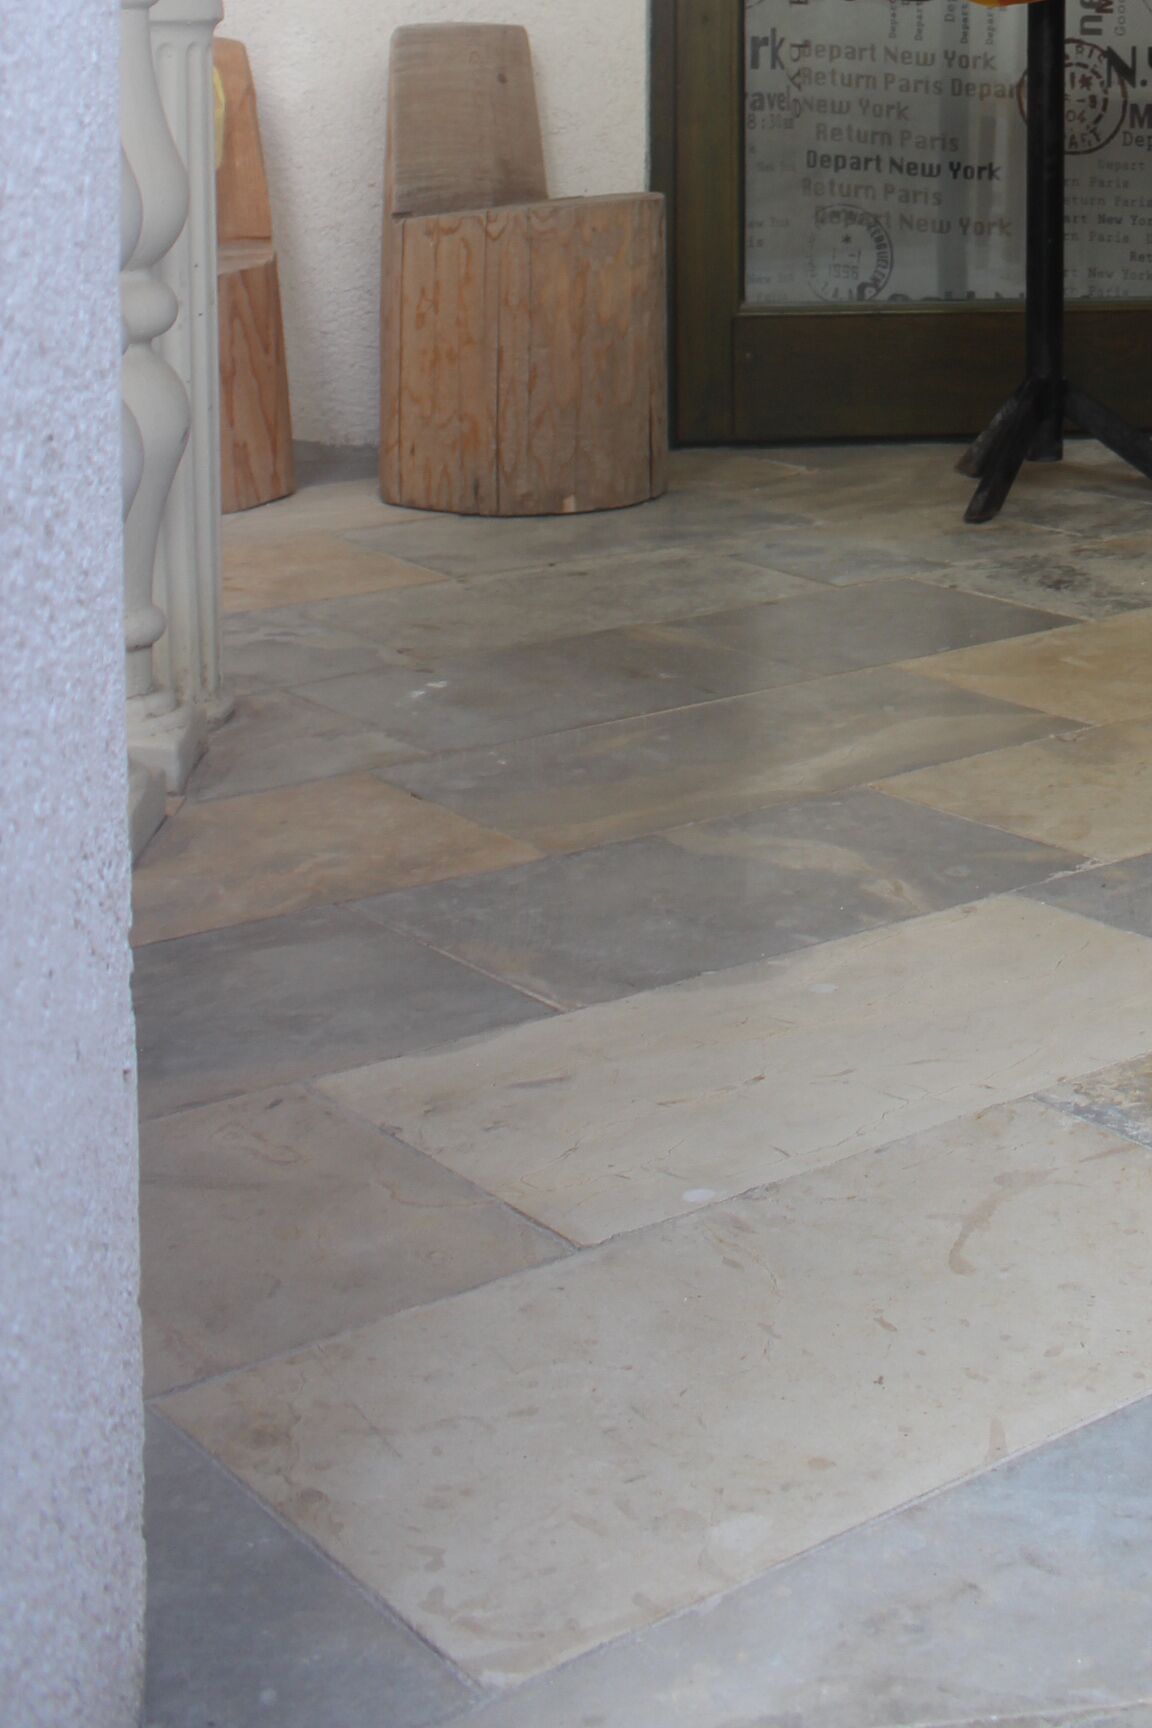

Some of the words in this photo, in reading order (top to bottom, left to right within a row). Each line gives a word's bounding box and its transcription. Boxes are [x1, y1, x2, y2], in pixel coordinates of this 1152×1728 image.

[985, 6, 995, 45] Depar
[883, 46, 936, 67] New
[943, 50, 998, 71] York
[800, 67, 877, 91] Return
[883, 73, 944, 97] Paris
[951, 78, 1016, 101] Depar
[802, 96, 850, 115] New
[858, 97, 910, 121] York
[815, 122, 893, 148] Return
[899, 129, 961, 153] Paris
[806, 149, 882, 174] Depart
[888, 155, 942, 179] New
[947, 159, 1002, 182] York
[801, 176, 877, 201] Return
[883, 183, 944, 206] Paris
[899, 212, 953, 235] New
[957, 215, 1013, 237] York
